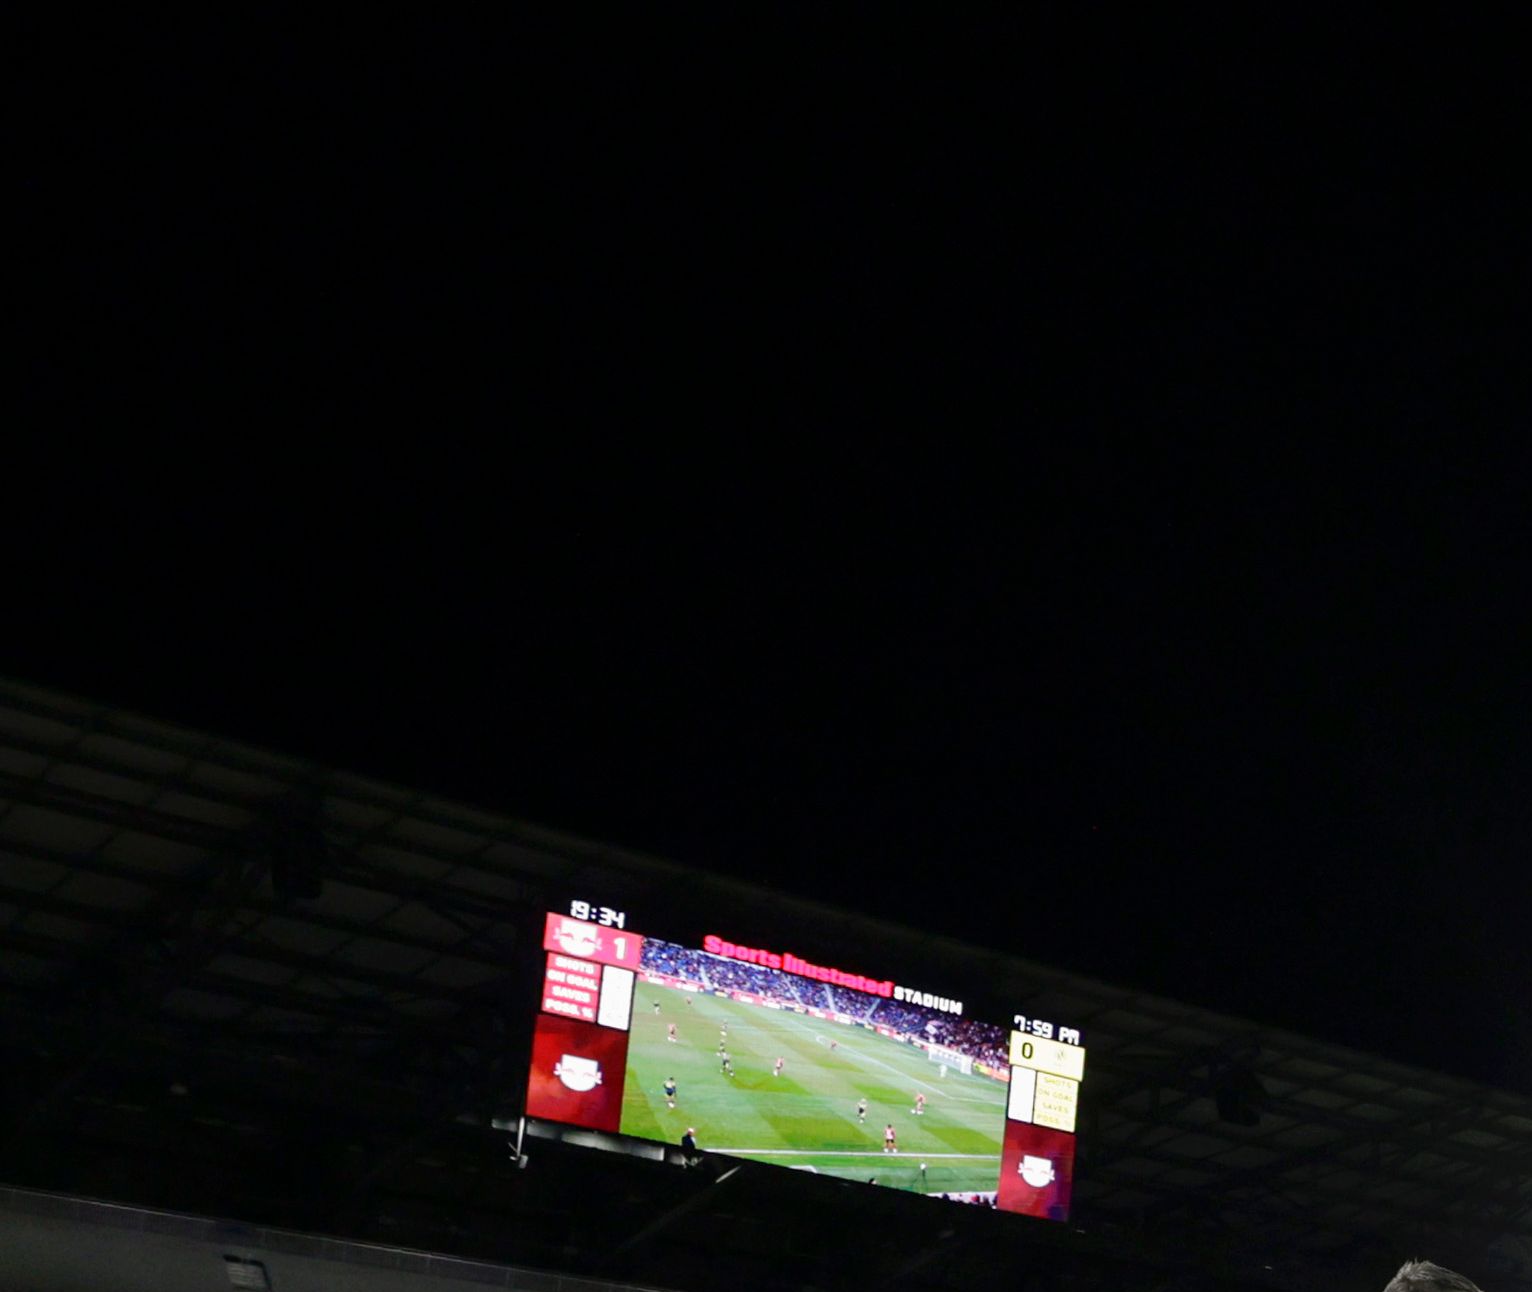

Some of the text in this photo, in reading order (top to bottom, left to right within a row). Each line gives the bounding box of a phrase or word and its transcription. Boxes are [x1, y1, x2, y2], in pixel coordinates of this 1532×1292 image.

[570, 900, 624, 928] 19:34
[614, 938, 626, 960] 1
[704, 934, 963, 1015] Sports Illustrated STADIUM
[1013, 1014, 1080, 1046] 7:59 PM
[1021, 1042, 1034, 1060] 0
